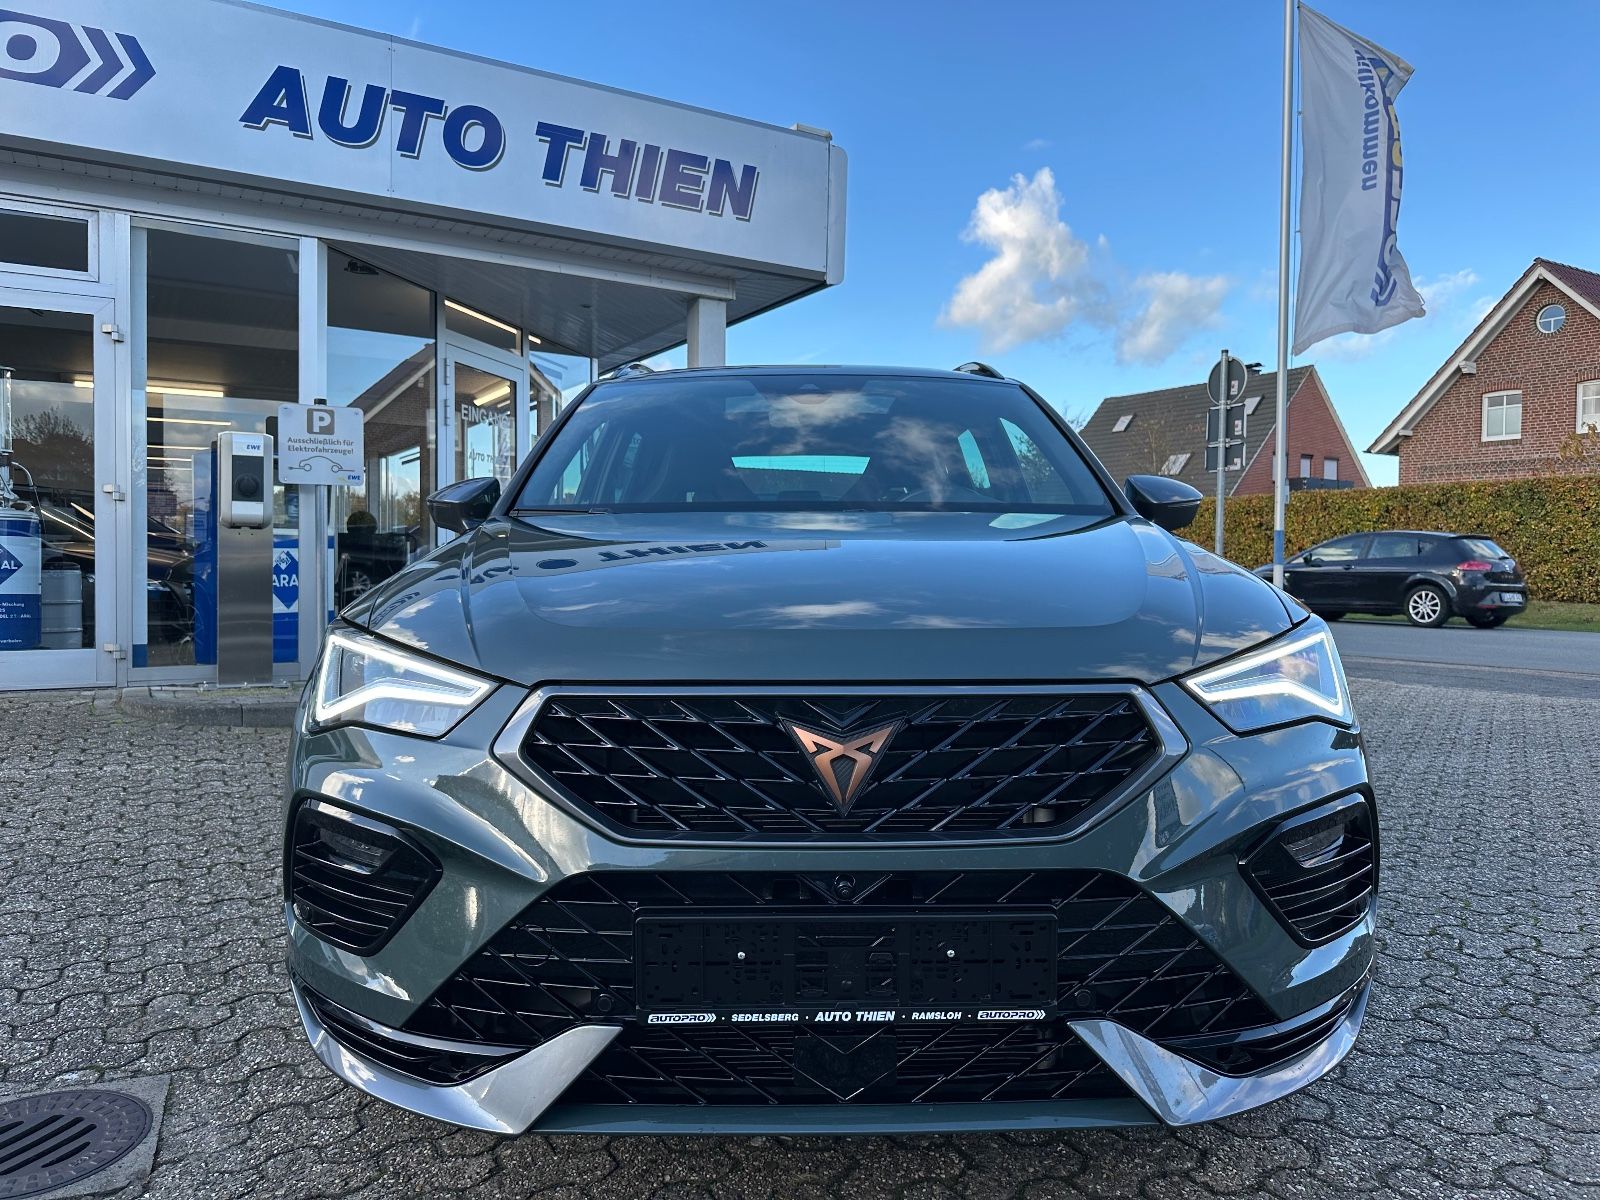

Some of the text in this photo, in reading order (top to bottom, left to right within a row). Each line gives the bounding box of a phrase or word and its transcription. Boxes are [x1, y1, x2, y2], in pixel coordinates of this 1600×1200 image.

[239, 65, 760, 222] AUTO THIEN
[313, 410, 331, 433] P
[288, 436, 354, 447] Ausschließlich für
[288, 445, 354, 456] Elektrofahrzeuge!
[731, 1013, 799, 1022] SEDELSBERG
[815, 1011, 852, 1022] AUTO
[856, 1011, 895, 1022] THIEN
[911, 1011, 962, 1020] RAMSLOH
